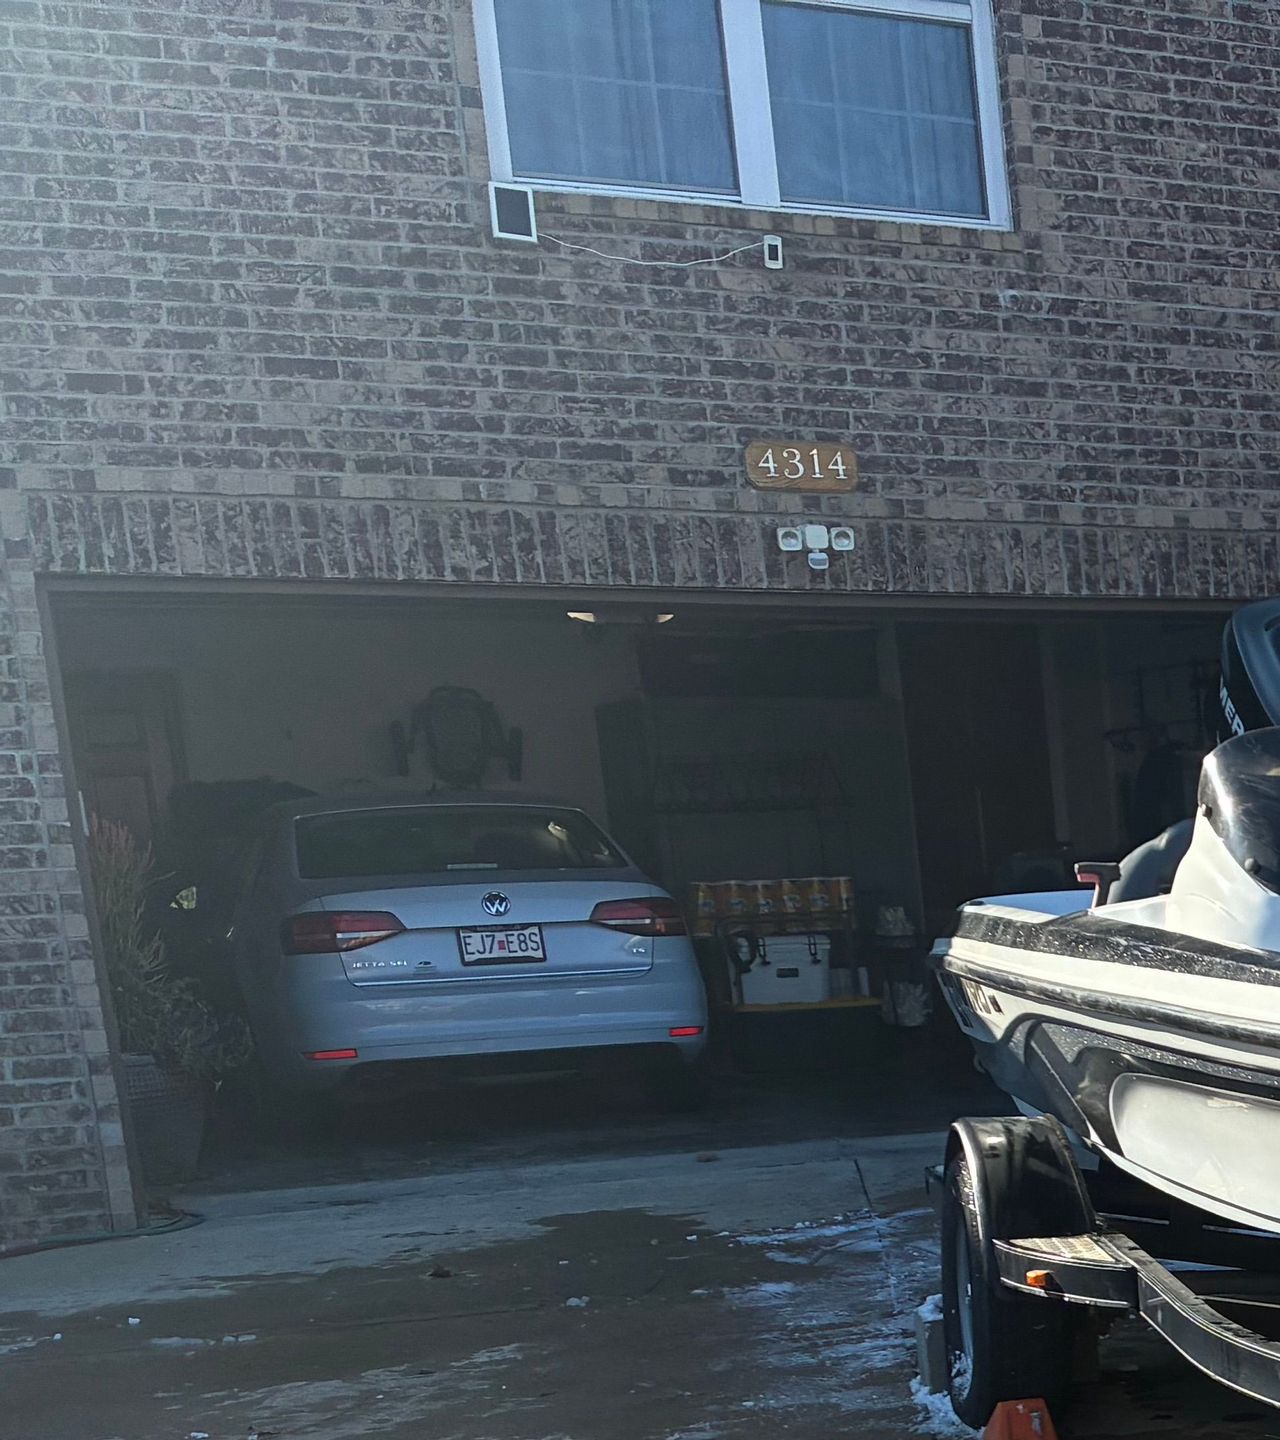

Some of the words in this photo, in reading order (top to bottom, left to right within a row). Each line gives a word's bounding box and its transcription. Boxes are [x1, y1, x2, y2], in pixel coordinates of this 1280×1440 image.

[758, 448, 849, 480] 4314
[462, 933, 496, 956] EJ7
[505, 931, 541, 954] E8S
